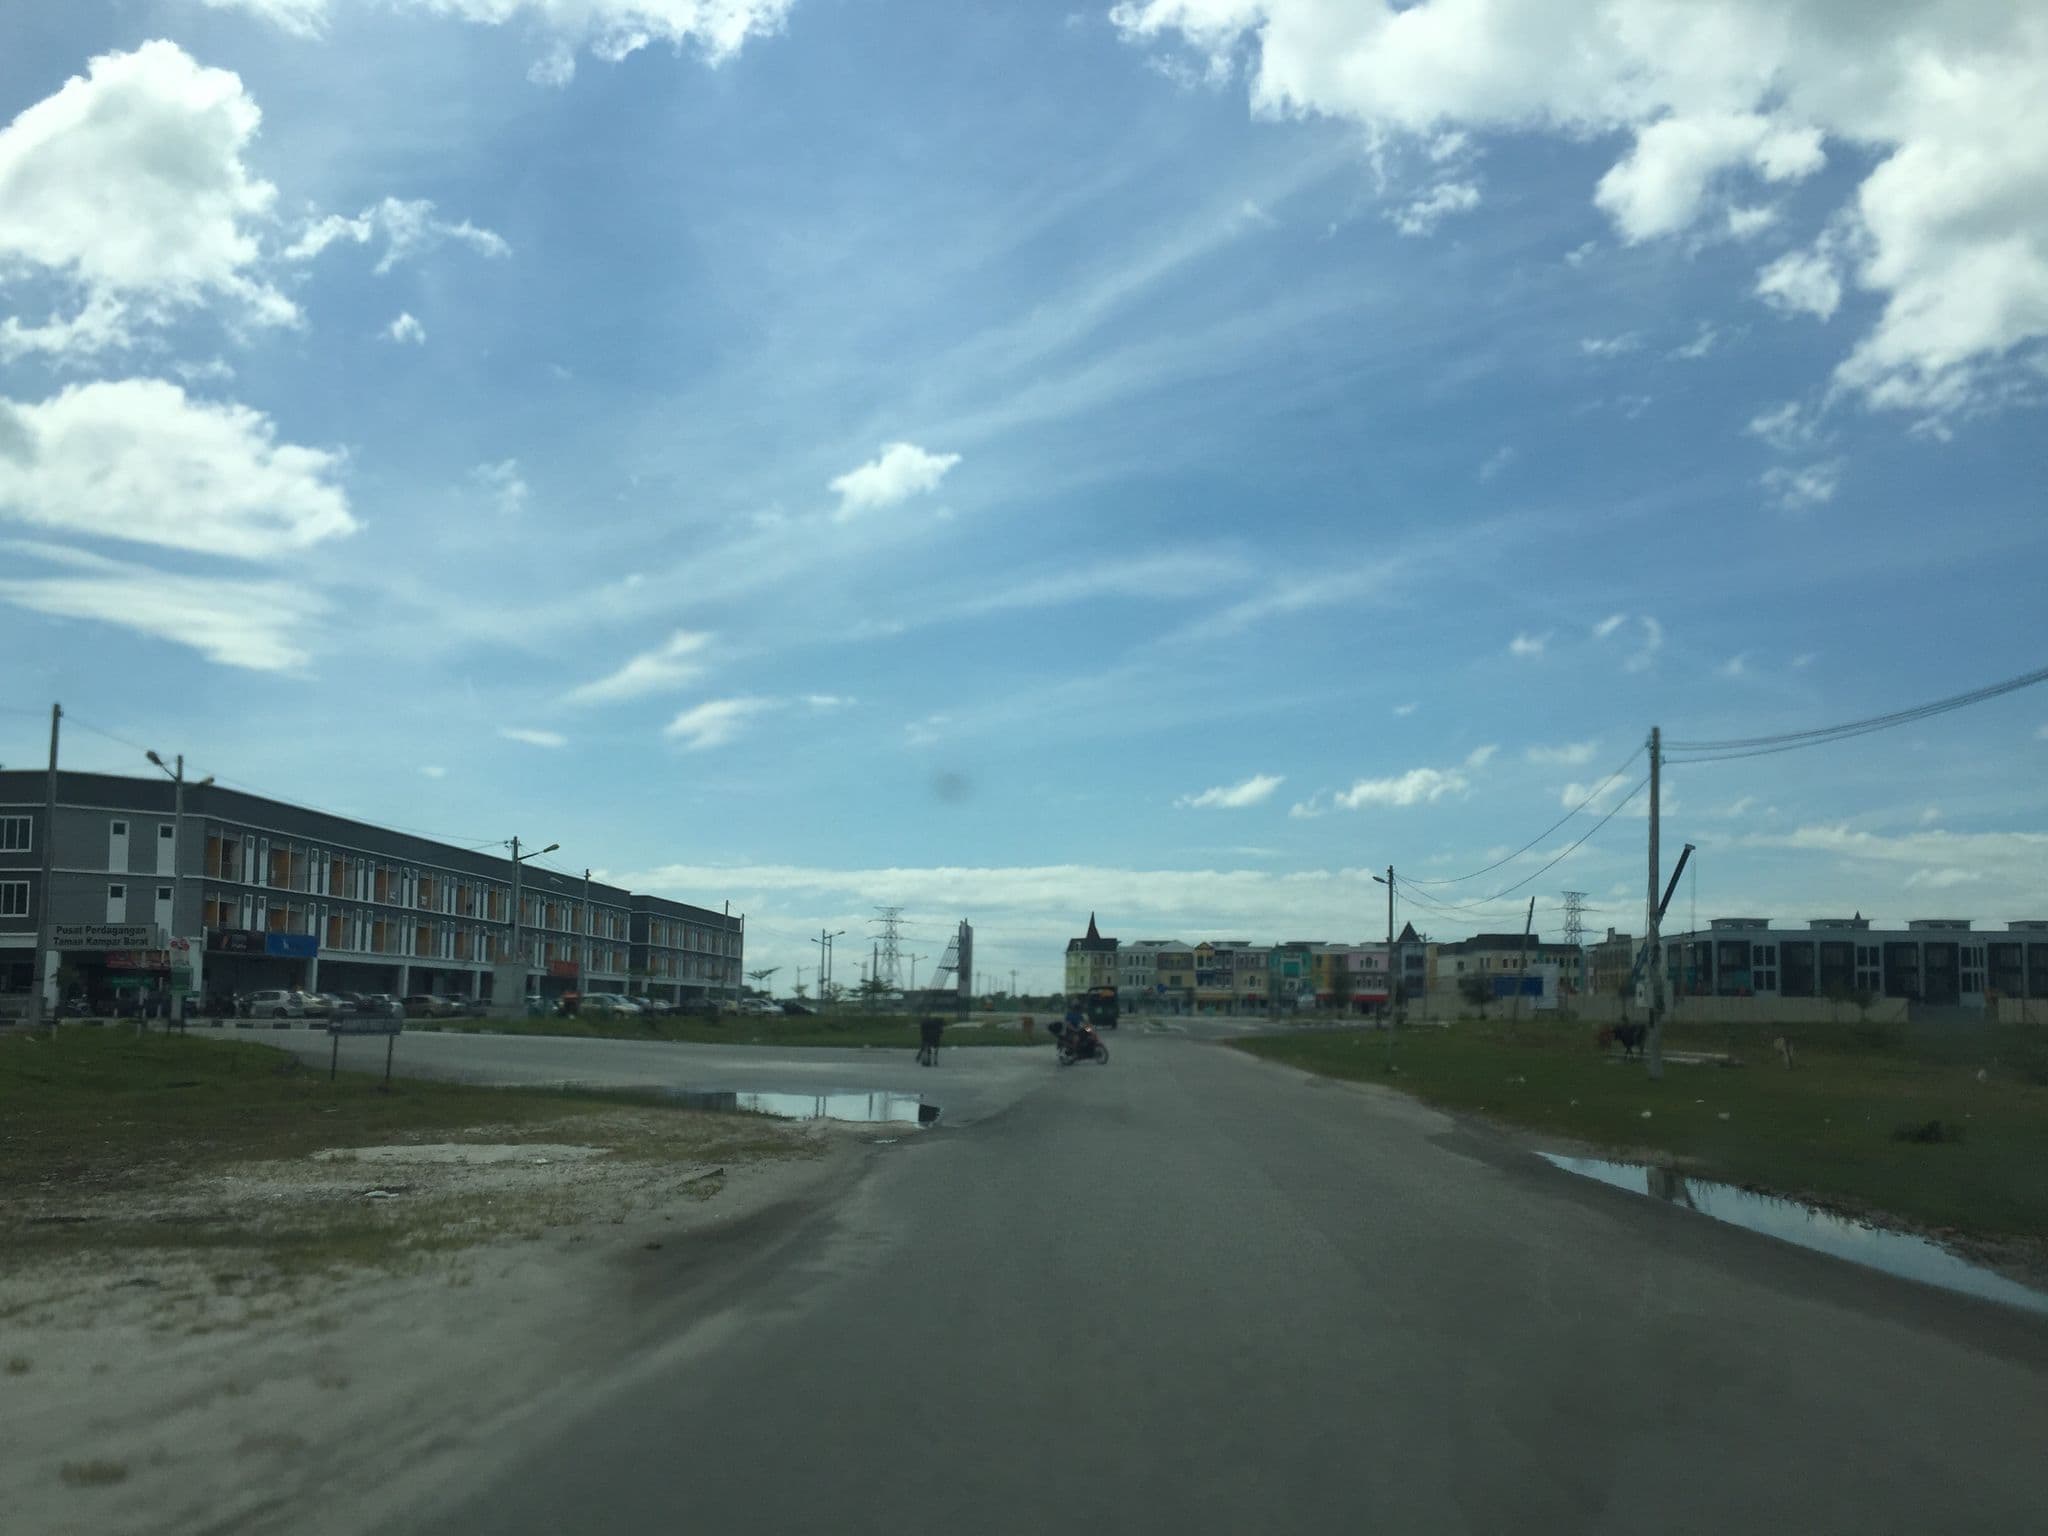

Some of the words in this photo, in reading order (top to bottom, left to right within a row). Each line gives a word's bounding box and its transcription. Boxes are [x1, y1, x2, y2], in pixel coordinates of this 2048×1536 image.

[56, 926, 82, 934] Pusat
[86, 926, 146, 936] Perdagangan
[53, 937, 83, 945] Taman
[86, 937, 121, 946] Kampar
[123, 937, 149, 945] Barat
